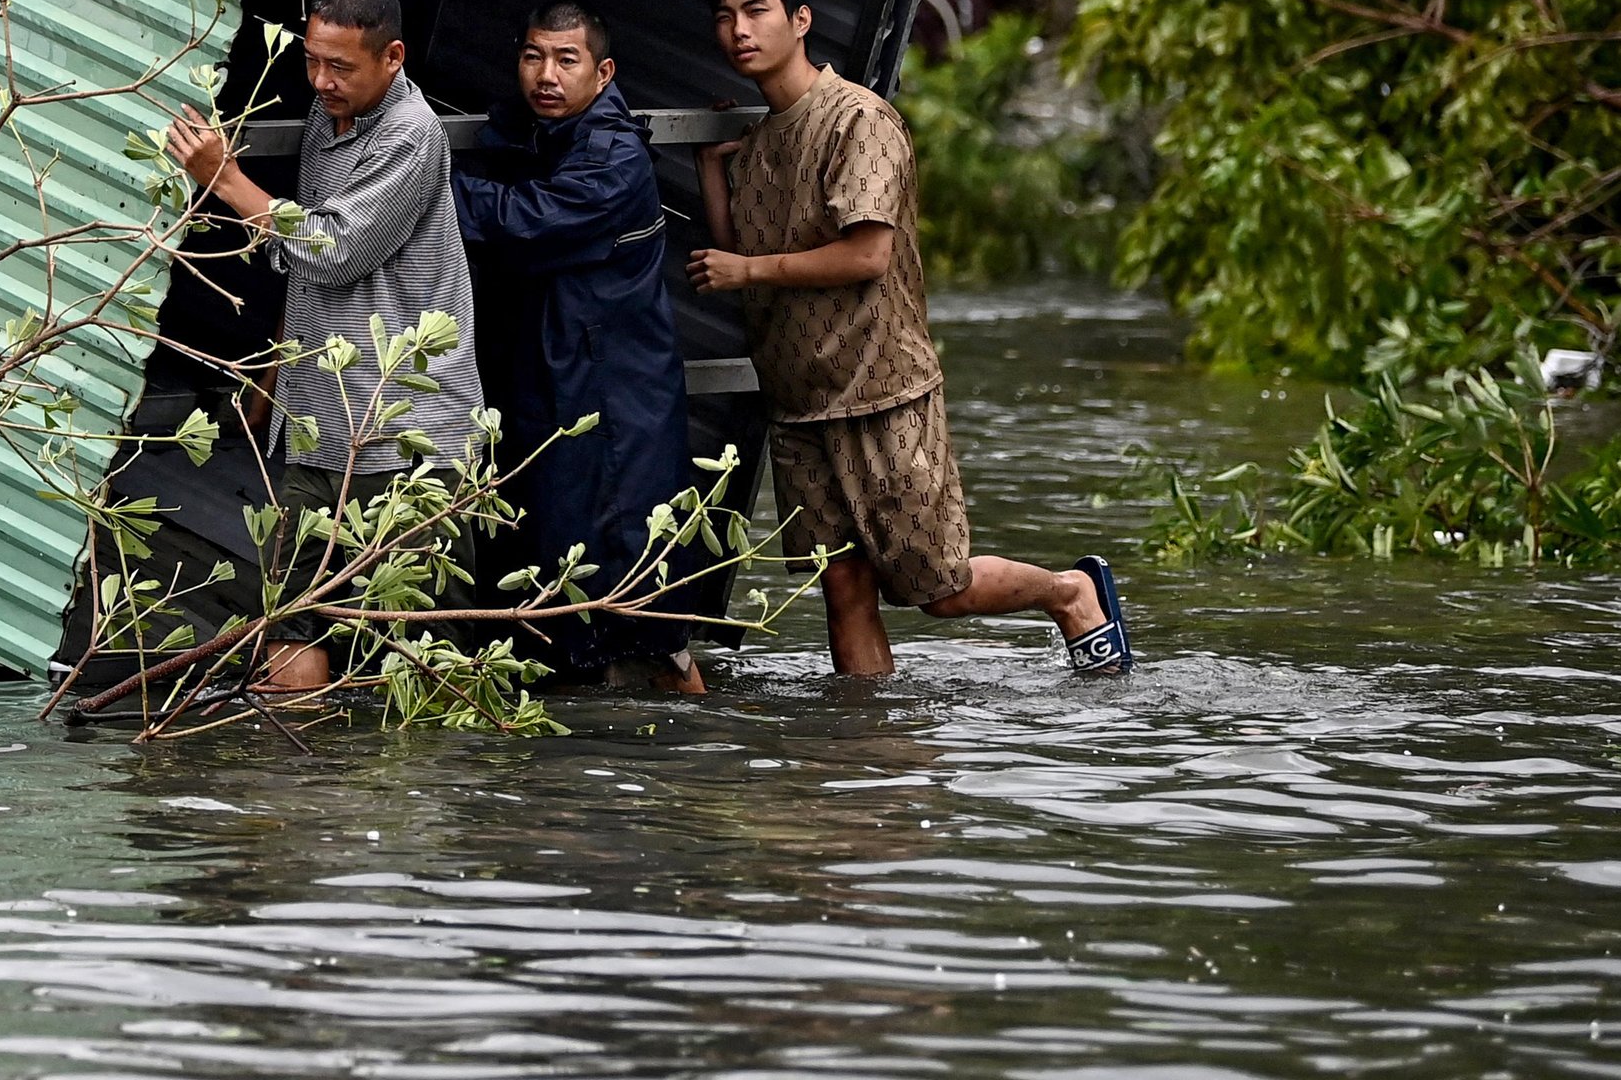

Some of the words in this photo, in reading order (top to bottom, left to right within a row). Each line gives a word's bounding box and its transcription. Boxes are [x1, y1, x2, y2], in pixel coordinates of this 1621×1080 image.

[821, 96, 829, 108] U
[848, 127, 854, 140] U
[870, 123, 876, 135] U
[780, 132, 787, 145] U
[796, 131, 802, 143] U
[859, 141, 865, 153] B
[882, 143, 888, 156] B
[757, 151, 762, 164] B
[774, 151, 780, 164] B
[839, 151, 846, 164] B
[871, 160, 878, 173] U
[892, 164, 898, 176] U
[767, 171, 774, 184] U
[801, 169, 808, 182] U
[860, 178, 867, 191] B
[900, 177, 907, 190] U
[757, 190, 762, 204] B
[874, 197, 880, 209] U
[849, 199, 855, 211] U
[745, 210, 752, 223] U
[769, 210, 775, 223] U
[801, 208, 807, 220] U
[758, 228, 764, 241] B
[792, 228, 799, 240] B
[880, 284, 887, 297] B
[809, 303, 815, 315] B
[834, 299, 841, 312] B
[871, 306, 879, 319] U
[848, 313, 855, 326] U
[800, 324, 806, 336] U
[824, 321, 832, 332] U
[864, 328, 871, 340] B
[815, 341, 822, 353] B
[839, 335, 847, 347] B
[857, 350, 863, 362] U
[879, 345, 884, 356] U
[830, 357, 840, 368] U
[889, 359, 895, 372] B
[869, 366, 874, 379] B
[924, 369, 930, 380] U
[881, 382, 888, 394] U
[907, 377, 914, 388] U
[857, 387, 864, 400] U
[884, 418, 890, 430] U
[909, 414, 916, 427] U
[920, 413, 927, 426] B
[863, 421, 869, 433] U
[934, 428, 940, 441] U
[834, 439, 840, 452] B
[899, 435, 906, 448] B
[888, 458, 895, 471] U
[932, 451, 939, 465] B
[848, 460, 854, 472] U
[865, 460, 872, 473] U
[809, 470, 816, 482] U
[904, 475, 912, 489] B
[880, 479, 886, 493] B
[895, 498, 902, 511] U
[921, 493, 928, 506] U
[850, 501, 857, 513] U
[942, 509, 949, 521] U
[865, 522, 871, 534] B
[886, 520, 893, 533] B
[913, 516, 920, 529] B
[834, 525, 840, 538] B
[957, 523, 965, 536] B
[810, 531, 816, 544] B
[929, 533, 936, 546] U
[902, 539, 910, 551] U
[953, 547, 963, 559] U
[894, 559, 901, 572] B
[921, 555, 928, 568] B
[936, 570, 942, 582] U
[950, 571, 958, 583] B
[911, 578, 918, 590] U
